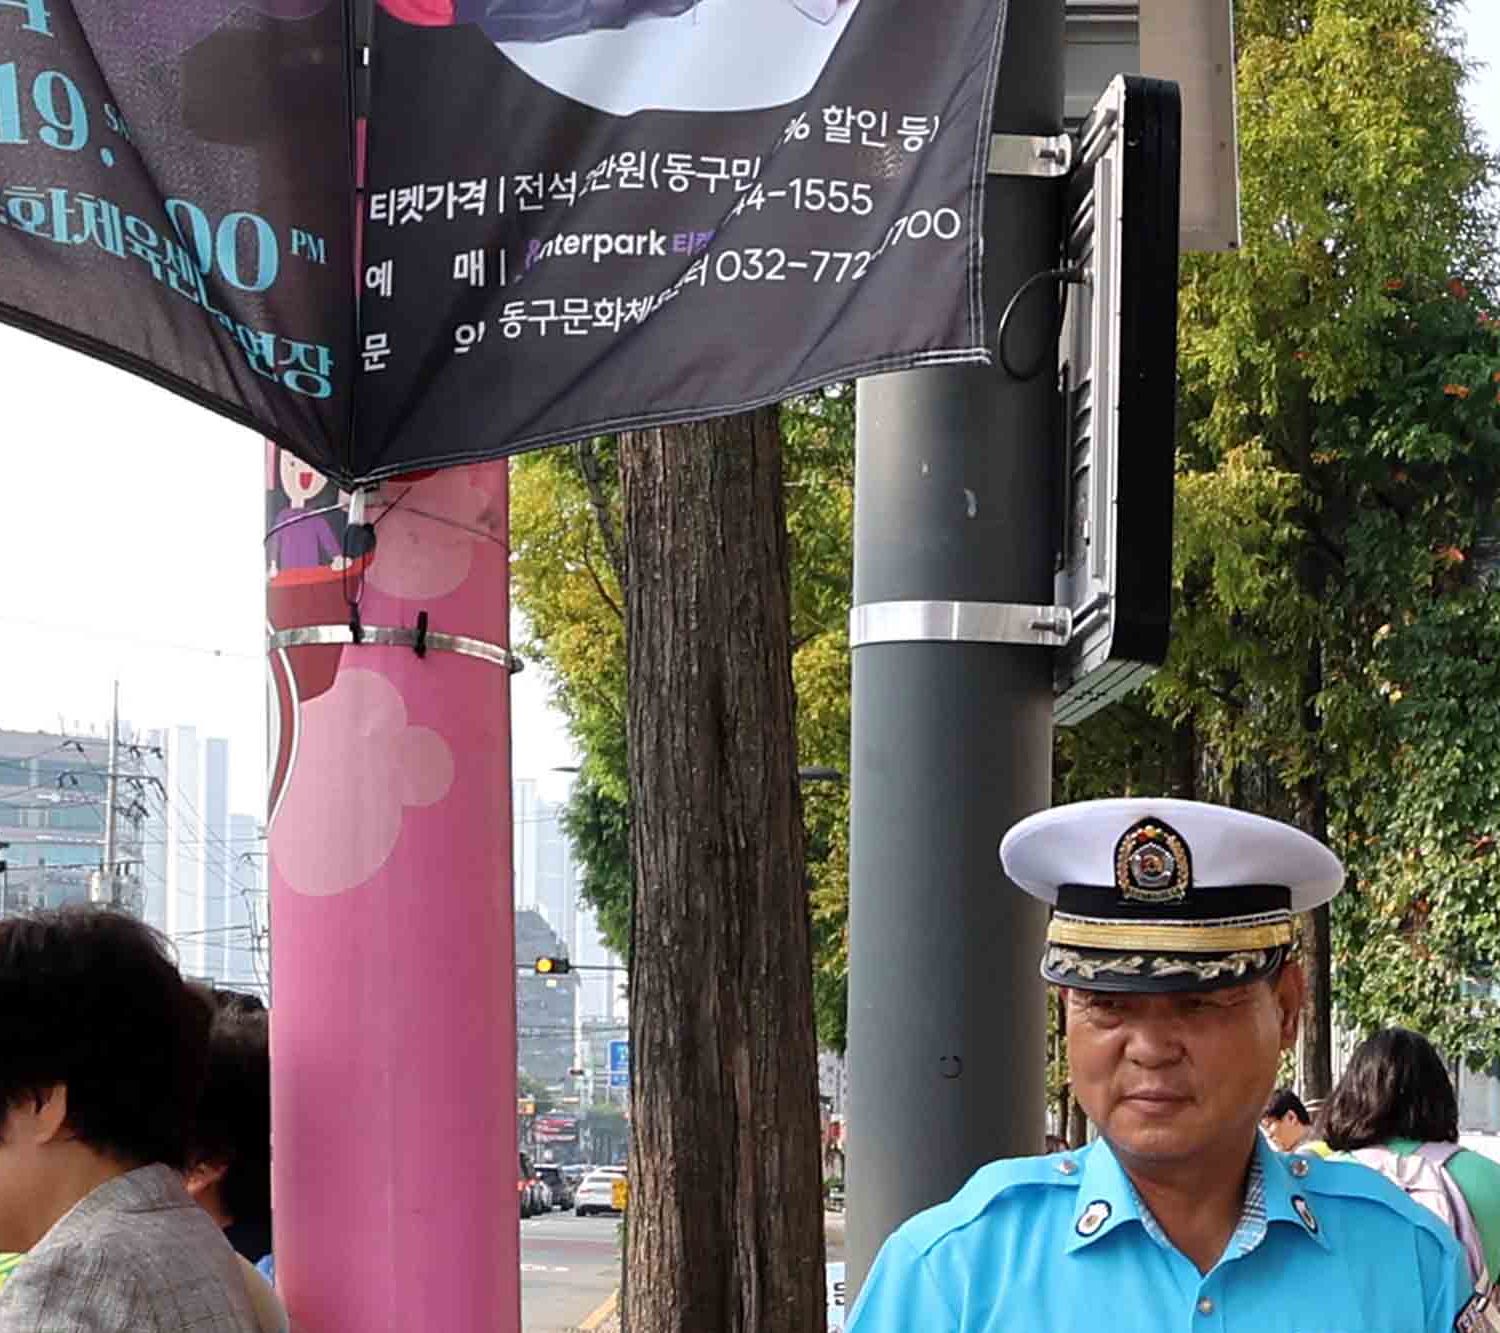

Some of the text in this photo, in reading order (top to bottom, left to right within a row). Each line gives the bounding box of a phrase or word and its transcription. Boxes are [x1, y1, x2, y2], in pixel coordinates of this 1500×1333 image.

[822, 104, 888, 149] 할인
[368, 179, 490, 226] 티켓가격
[513, 176, 578, 214] 전석
[291, 228, 328, 265] PM
[365, 259, 394, 298] 예
[361, 332, 392, 372] 문
